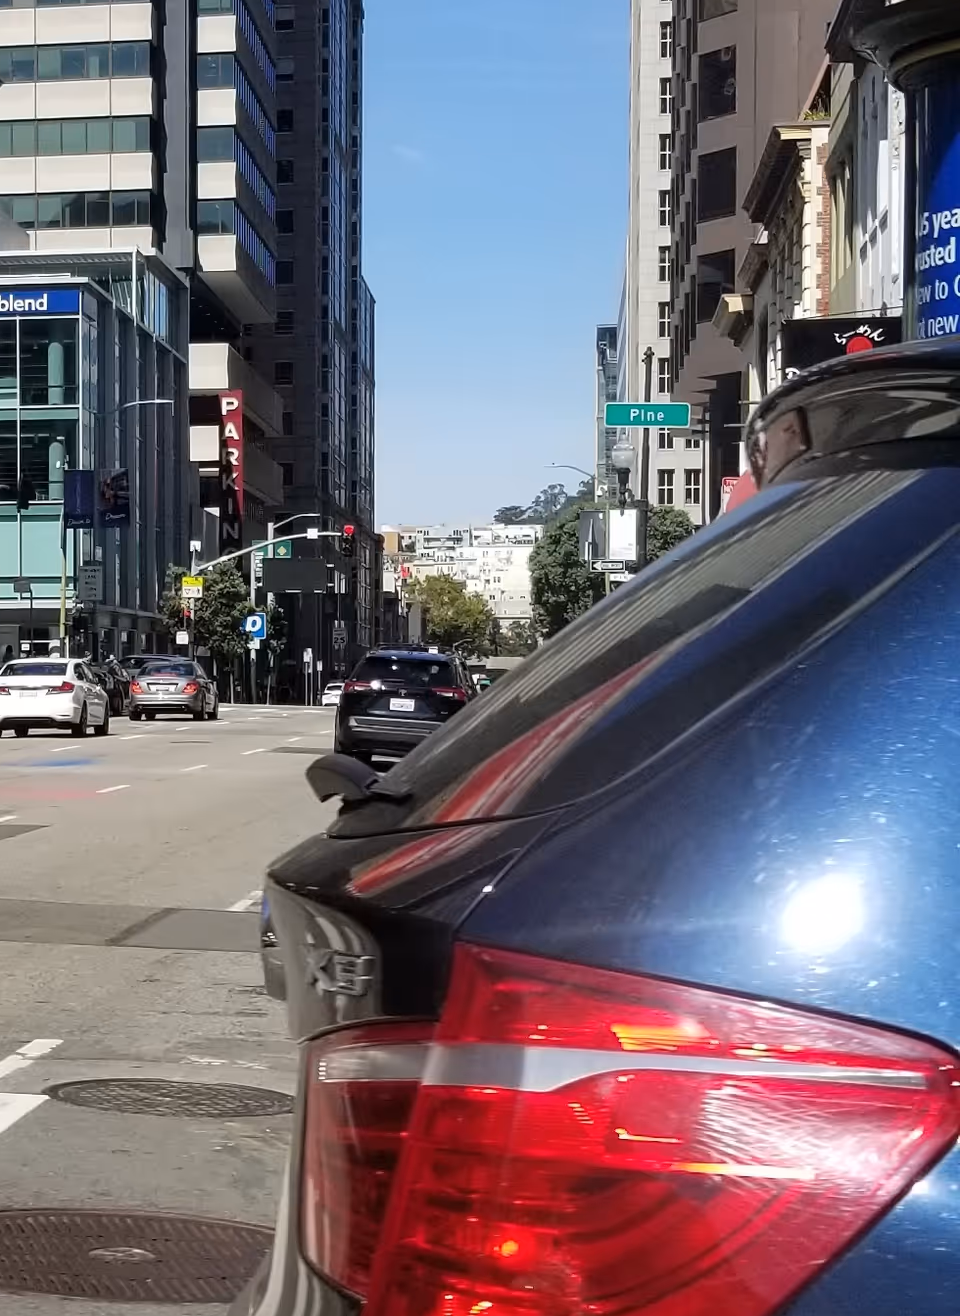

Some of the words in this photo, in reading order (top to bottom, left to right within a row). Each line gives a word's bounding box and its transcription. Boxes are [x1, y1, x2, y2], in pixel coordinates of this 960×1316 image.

[935, 279, 949, 300] to
[833, 323, 886, 347] らーめん
[927, 314, 959, 338] new
[629, 408, 665, 422] Pine
